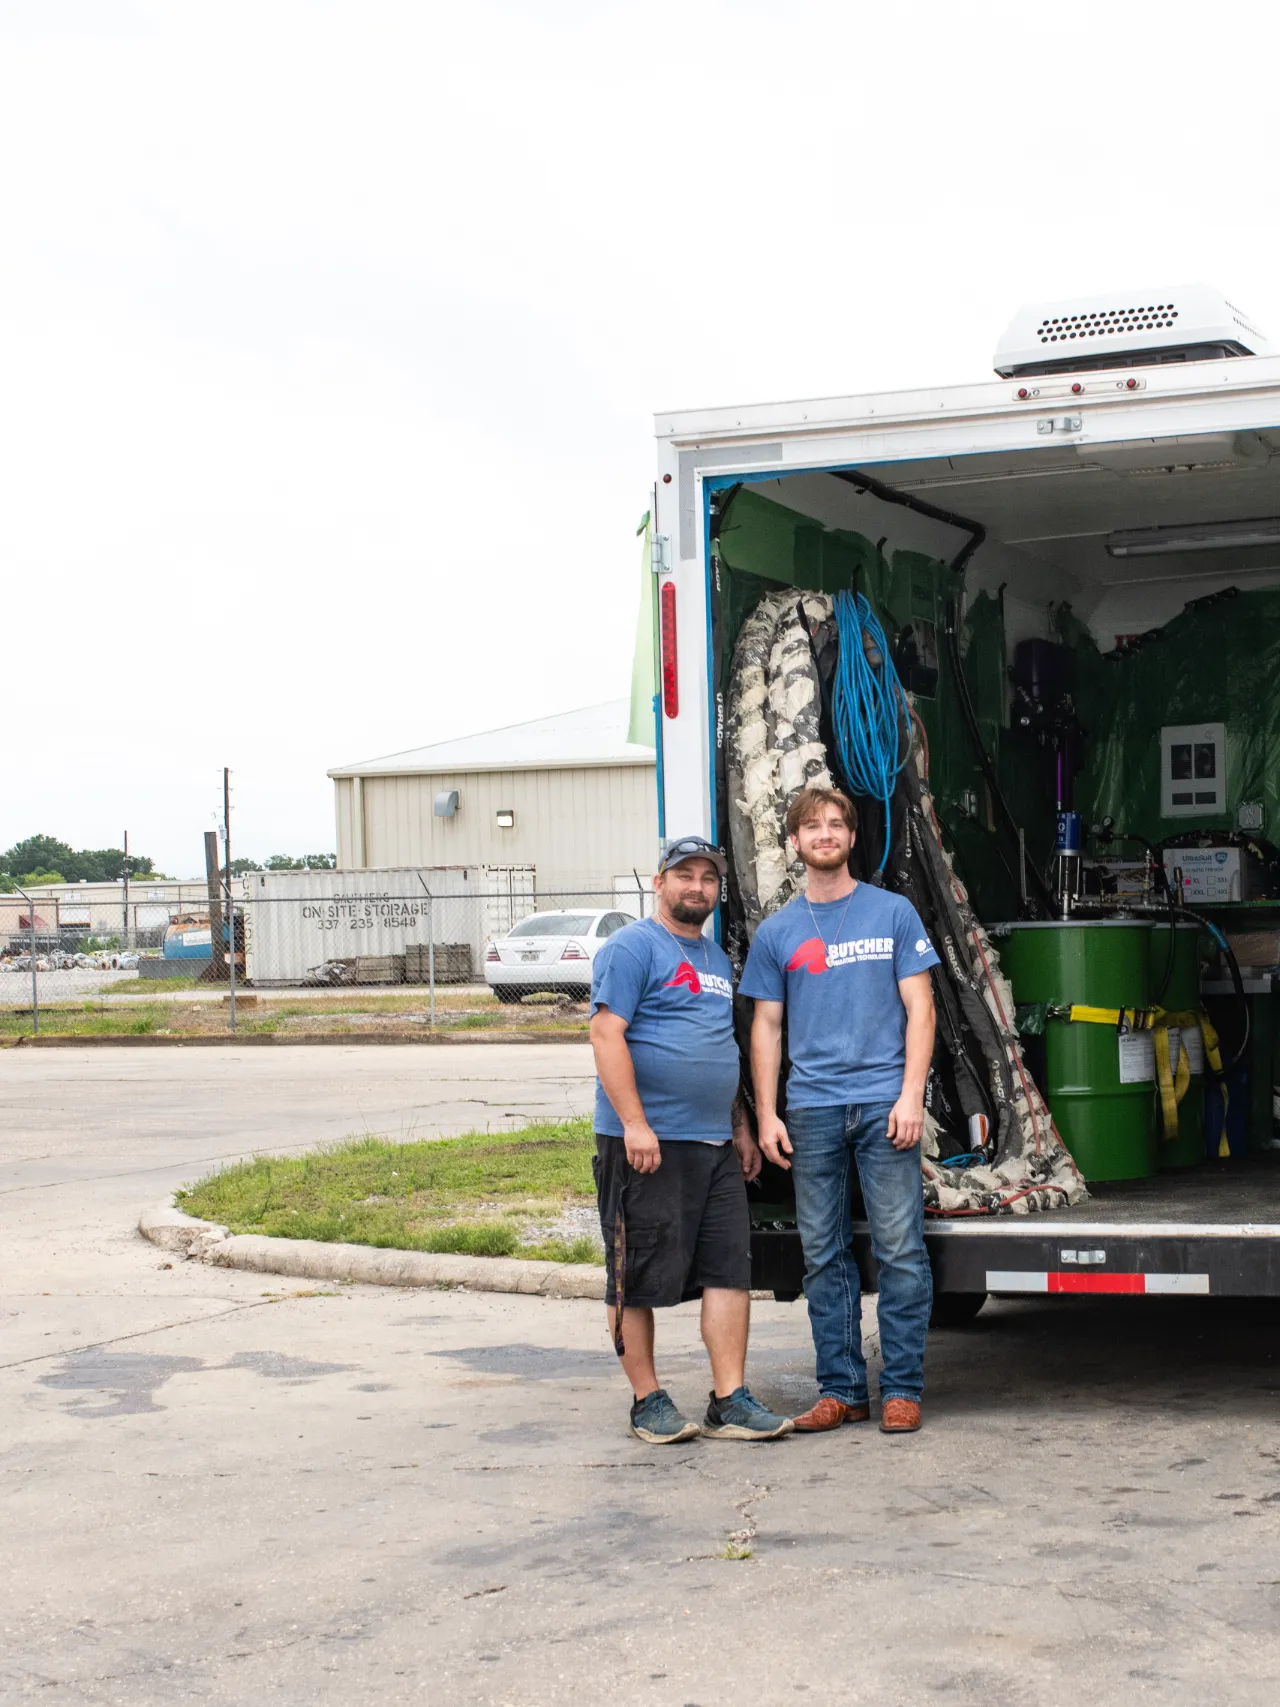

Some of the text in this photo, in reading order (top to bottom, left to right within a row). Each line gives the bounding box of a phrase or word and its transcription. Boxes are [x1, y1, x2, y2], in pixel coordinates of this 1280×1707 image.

[716, 704, 724, 749] GRACO
[720, 875, 728, 903] ACO
[364, 902, 429, 917] STORAGE
[317, 916, 417, 930] 337 235 8548
[827, 937, 894, 960] BUTCHER
[697, 971, 733, 997] BUTCH
